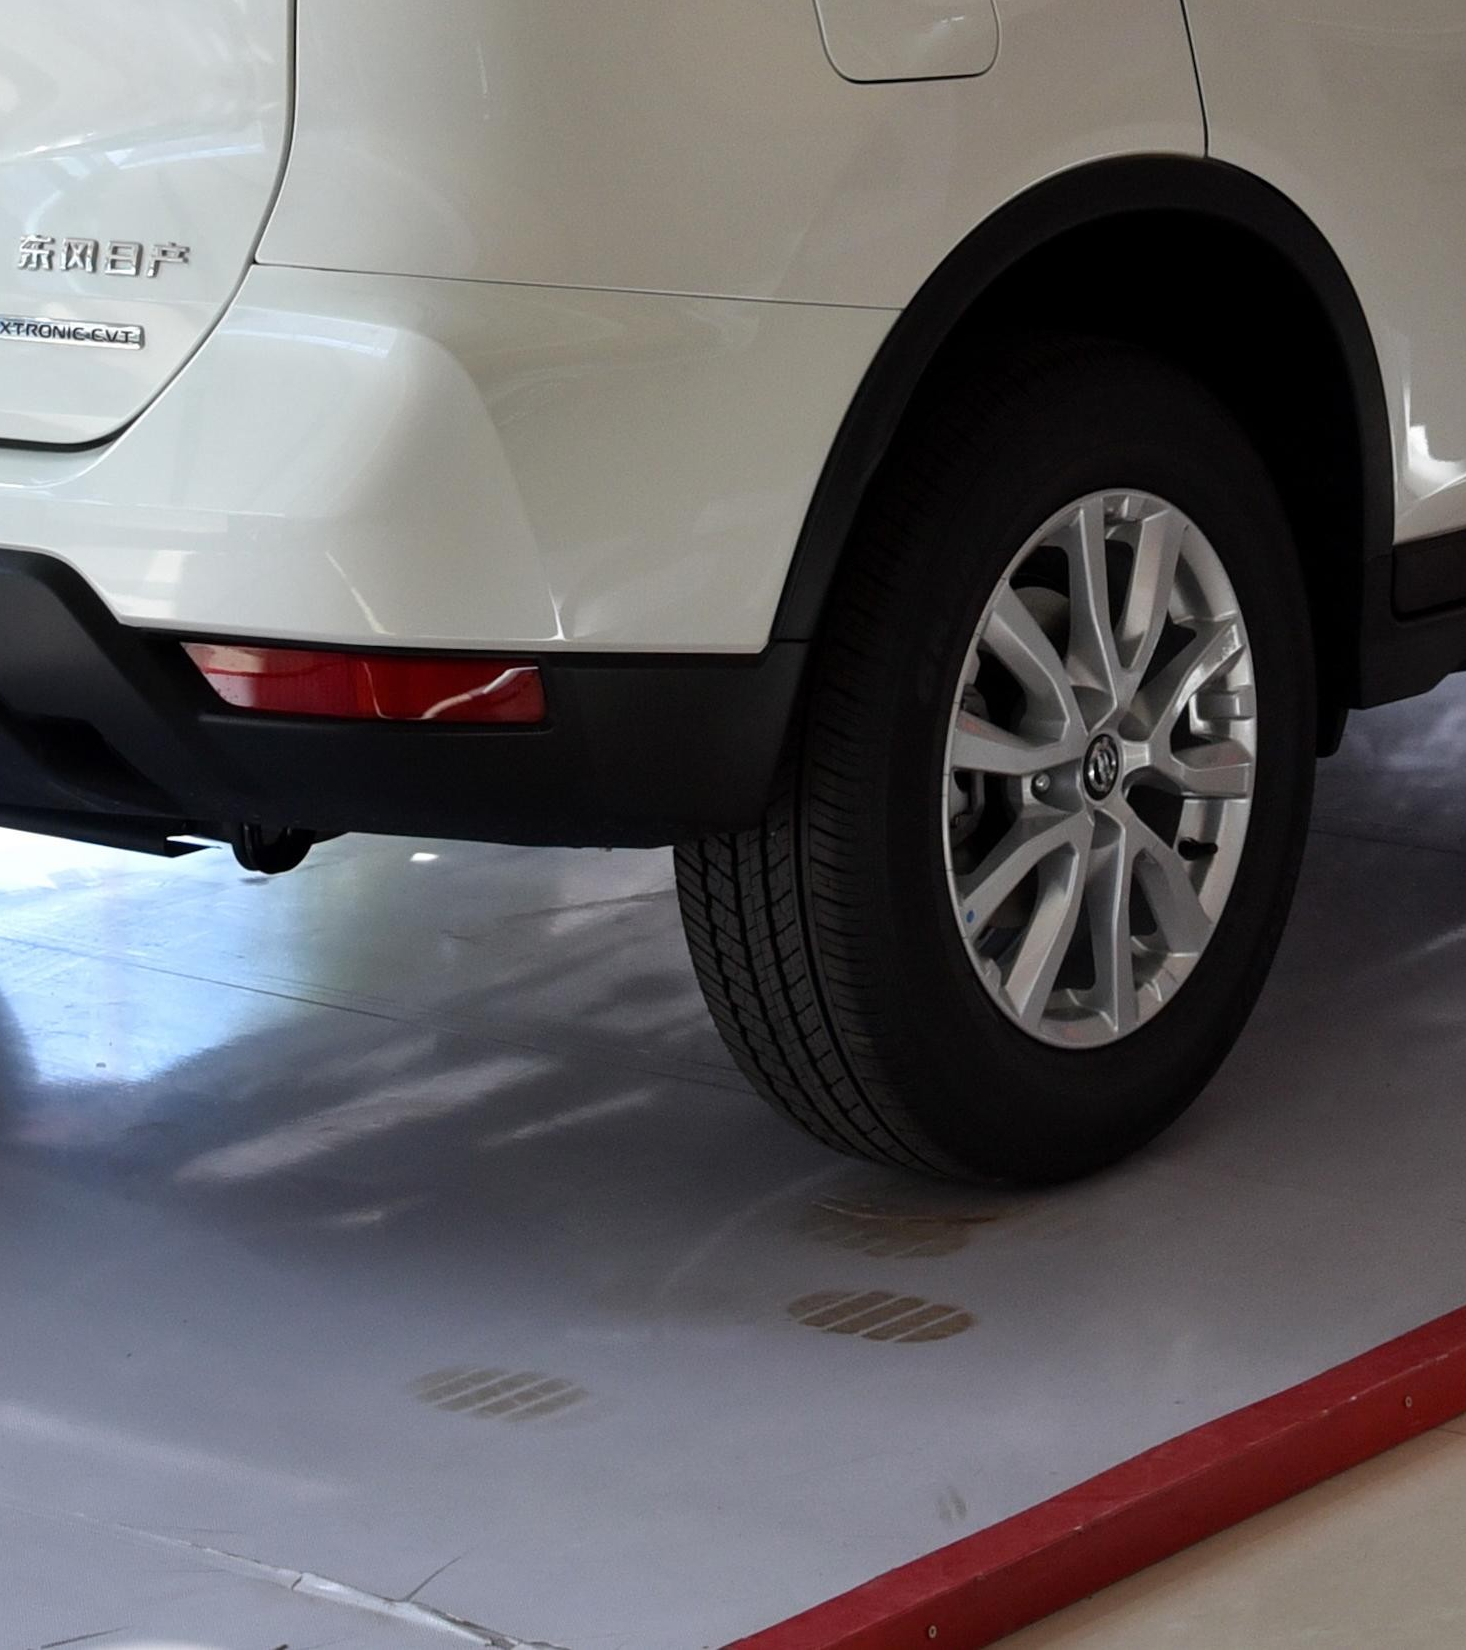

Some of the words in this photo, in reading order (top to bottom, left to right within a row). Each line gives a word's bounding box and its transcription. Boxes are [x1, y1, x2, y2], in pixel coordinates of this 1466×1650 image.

[17, 234, 190, 278] 东风日产
[91, 329, 133, 344] CVT
